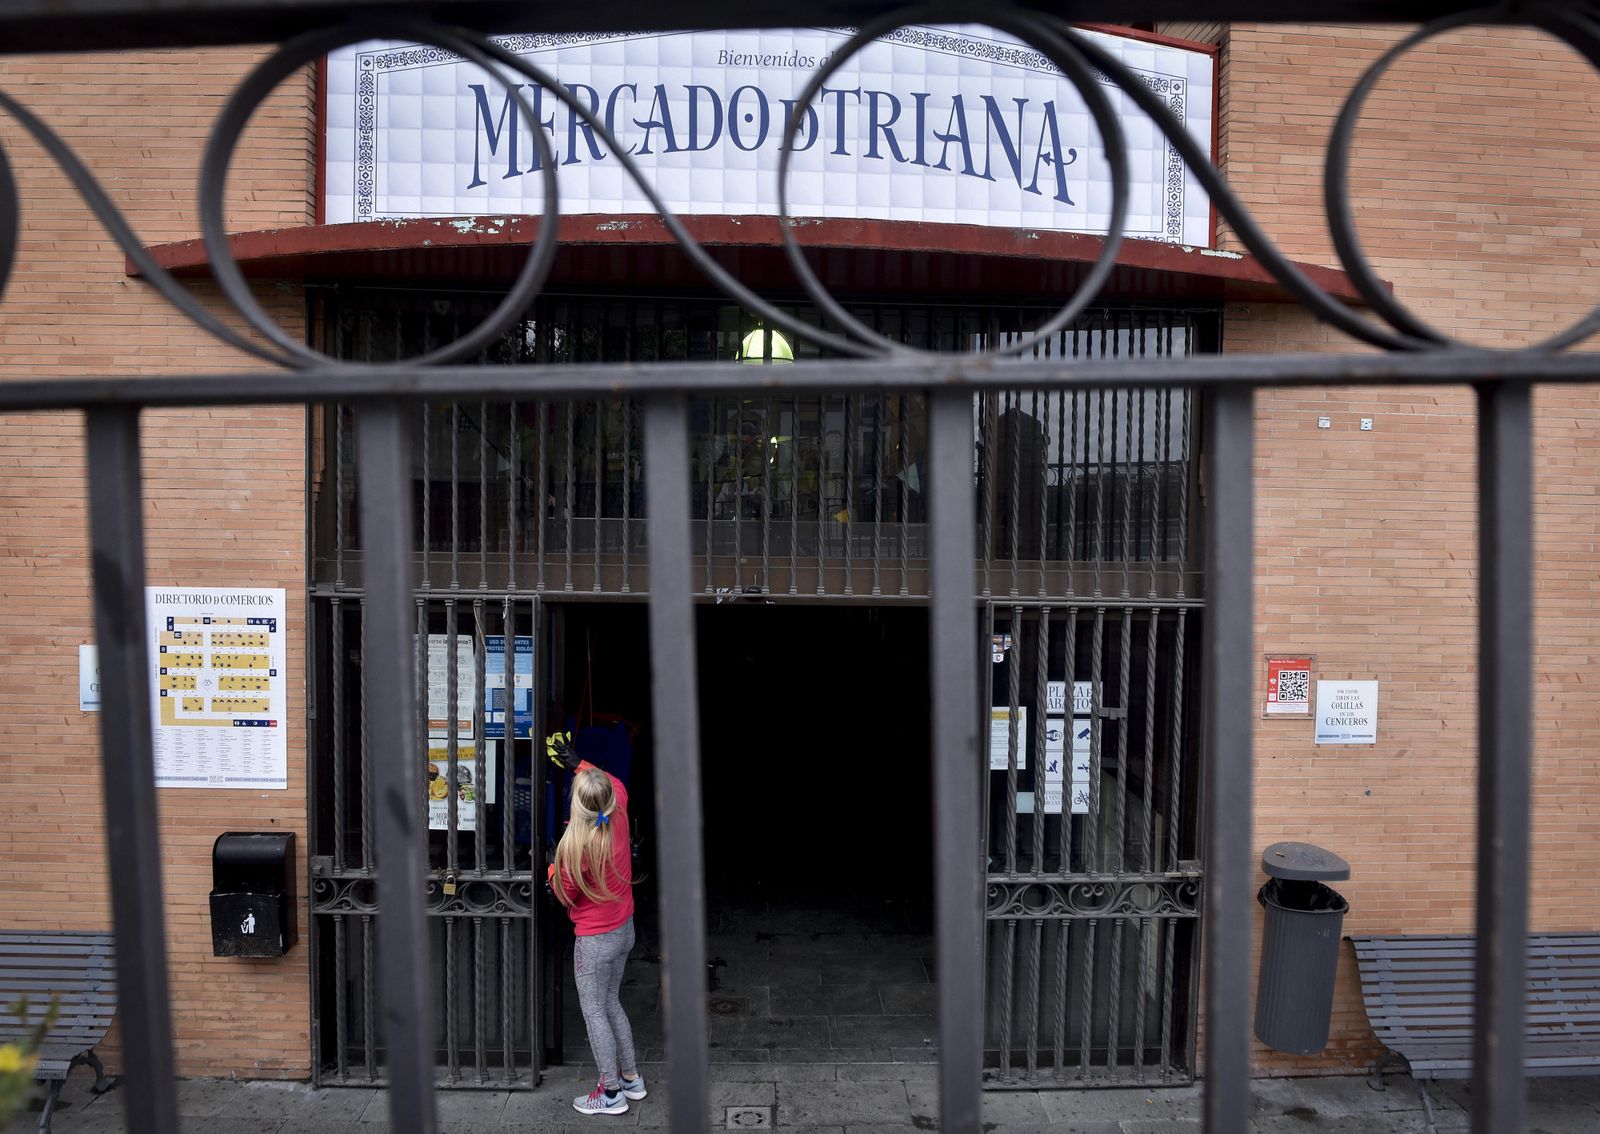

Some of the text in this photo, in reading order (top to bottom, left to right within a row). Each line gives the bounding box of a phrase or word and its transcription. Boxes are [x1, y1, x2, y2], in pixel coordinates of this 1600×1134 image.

[718, 49, 815, 67] Bienvenidos
[466, 80, 770, 190] MERCADO
[821, 85, 1078, 207] TRIANA
[155, 593, 212, 605] DIRECTORIO
[220, 595, 274, 606] COMERCIOS
[1049, 686, 1084, 697] PLZA
[1331, 701, 1364, 710] COLILLAS
[1325, 716, 1369, 726] CENICEROS
